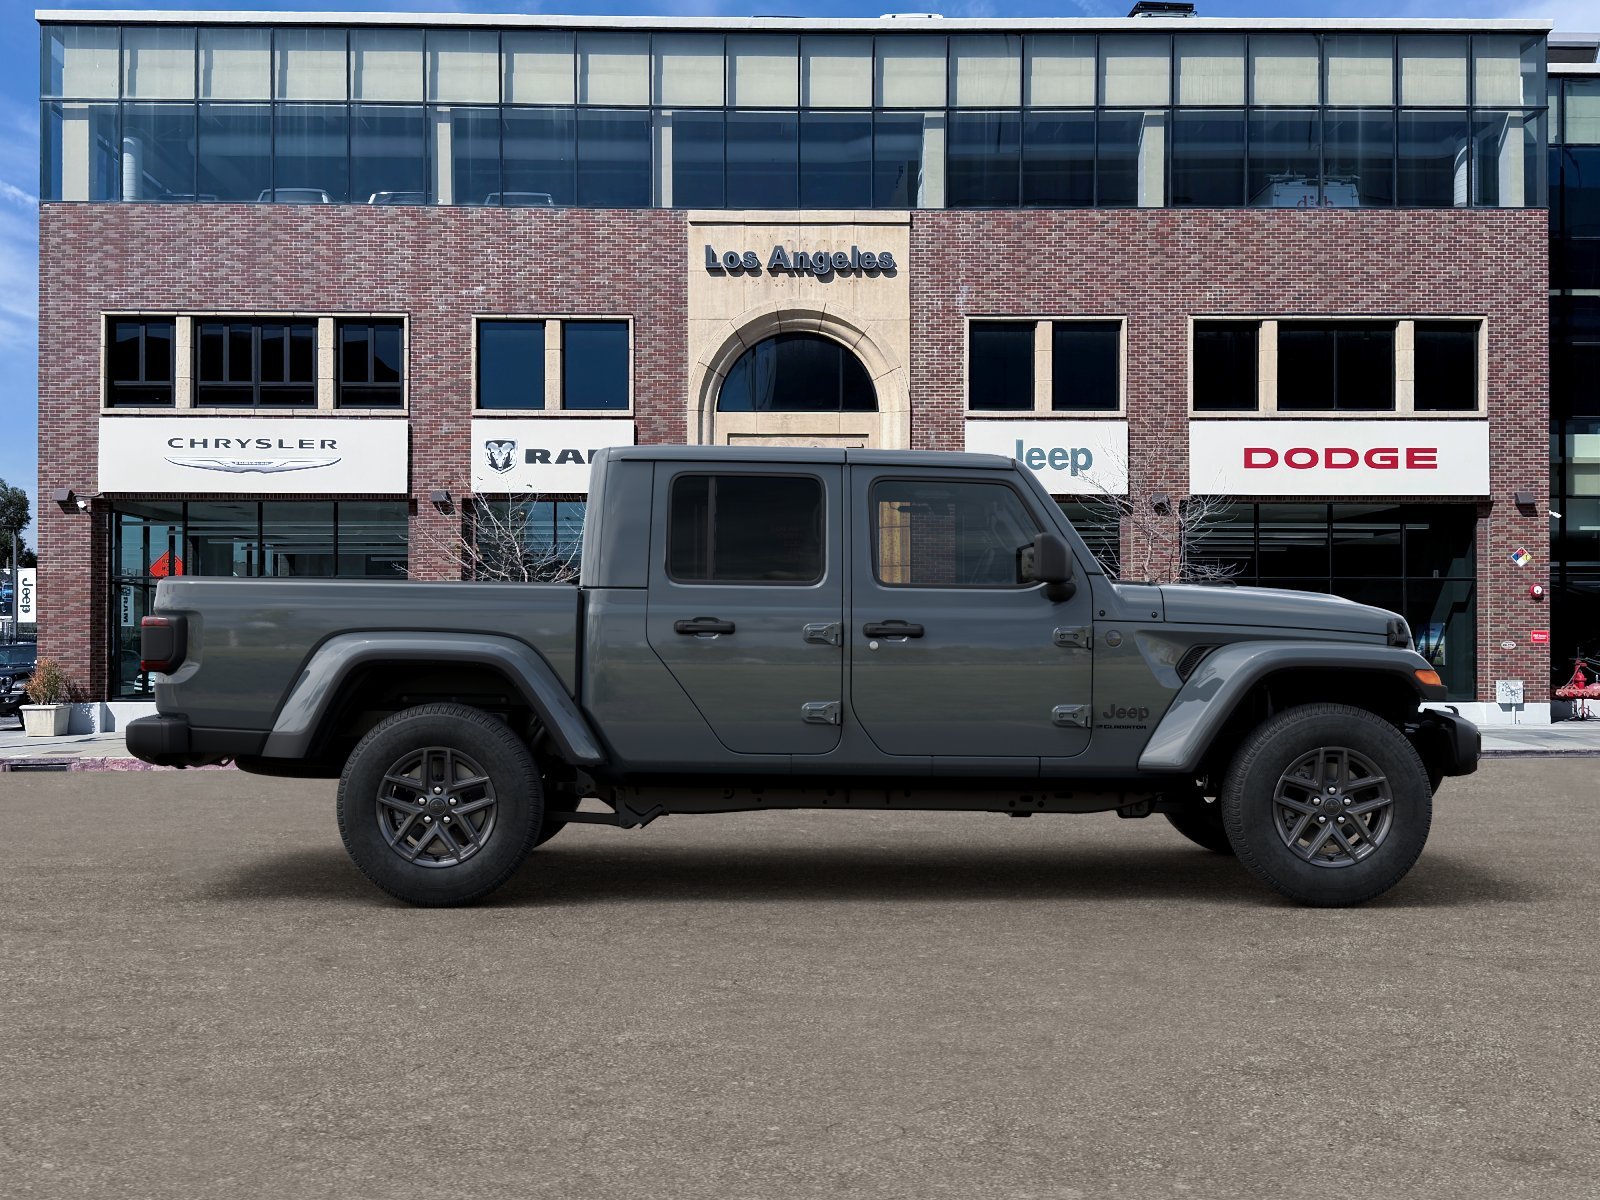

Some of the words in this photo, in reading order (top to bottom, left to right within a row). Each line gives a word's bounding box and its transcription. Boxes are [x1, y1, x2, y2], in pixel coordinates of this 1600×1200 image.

[705, 245, 758, 269] Los
[767, 245, 894, 275] Angeles
[167, 437, 338, 449] CHRYSLER
[1243, 447, 1438, 469] DODGE
[20, 578, 33, 613] Jeep
[1103, 704, 1149, 721] Jeep
